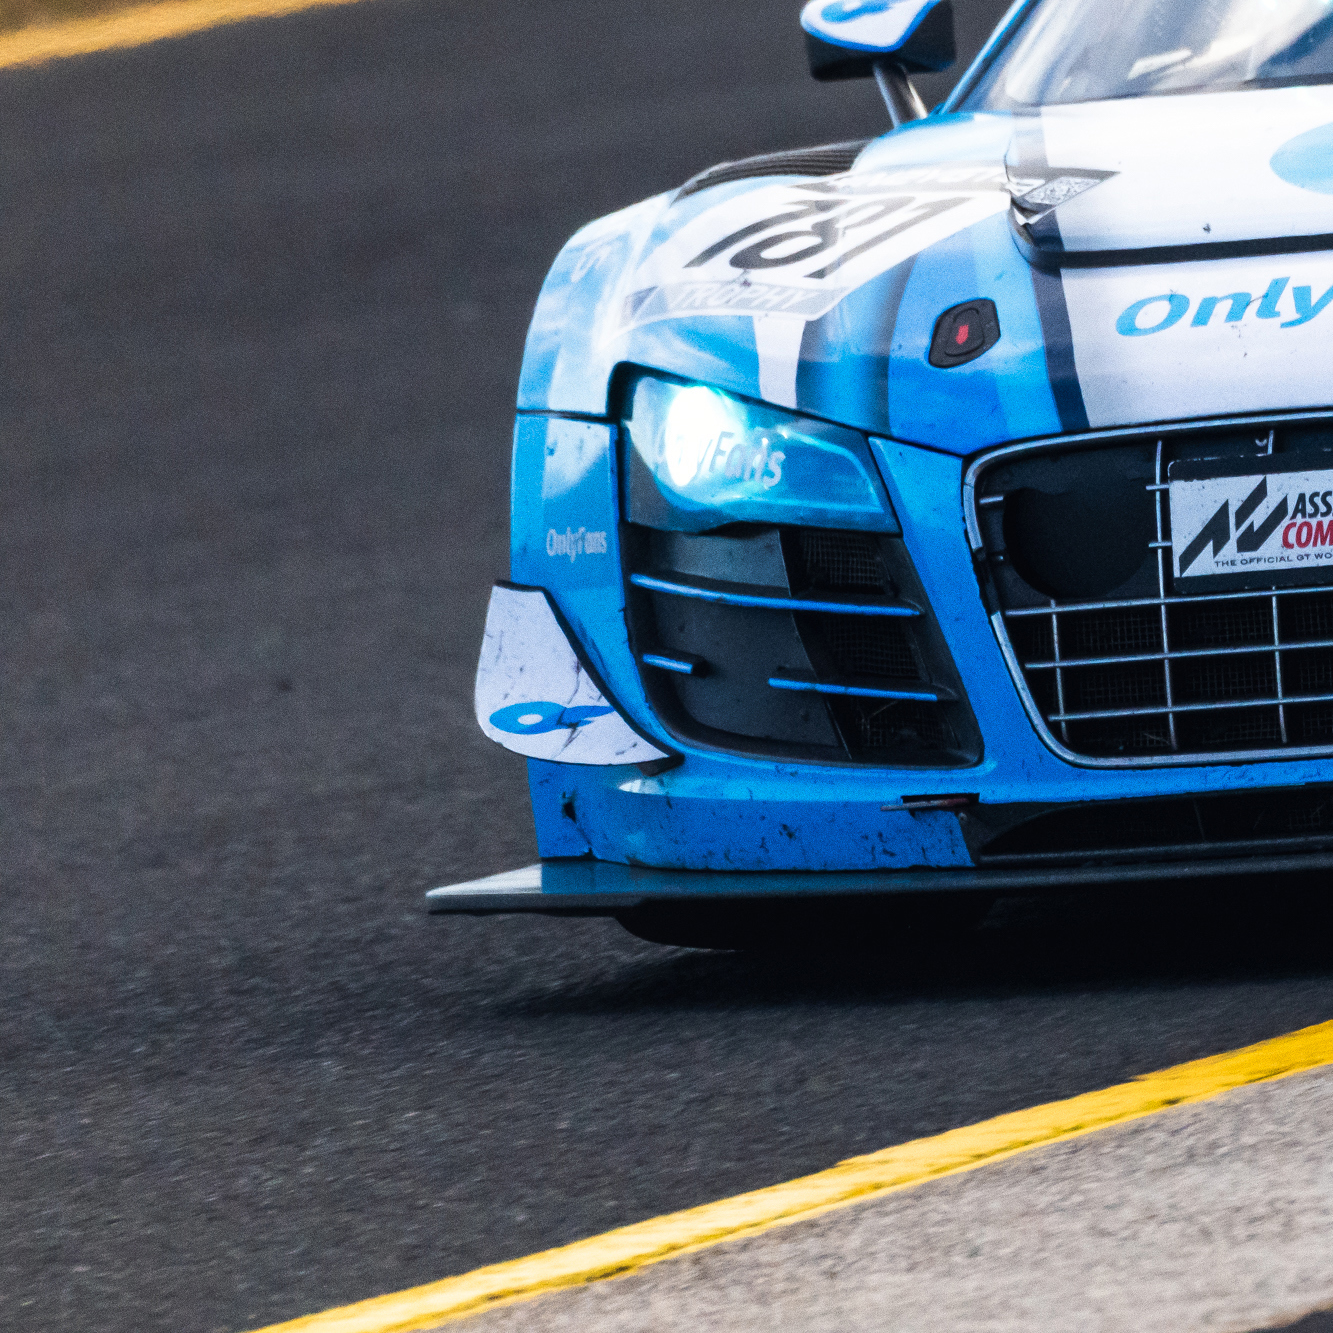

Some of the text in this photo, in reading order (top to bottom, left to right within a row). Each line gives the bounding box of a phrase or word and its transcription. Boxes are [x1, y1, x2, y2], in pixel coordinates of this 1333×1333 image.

[668, 281, 823, 311] TROPHY
[546, 526, 608, 563] OnlyFans
[1214, 559, 1237, 568] THE
[1240, 555, 1293, 566] OFFICIAL
[1296, 553, 1311, 562] GT
